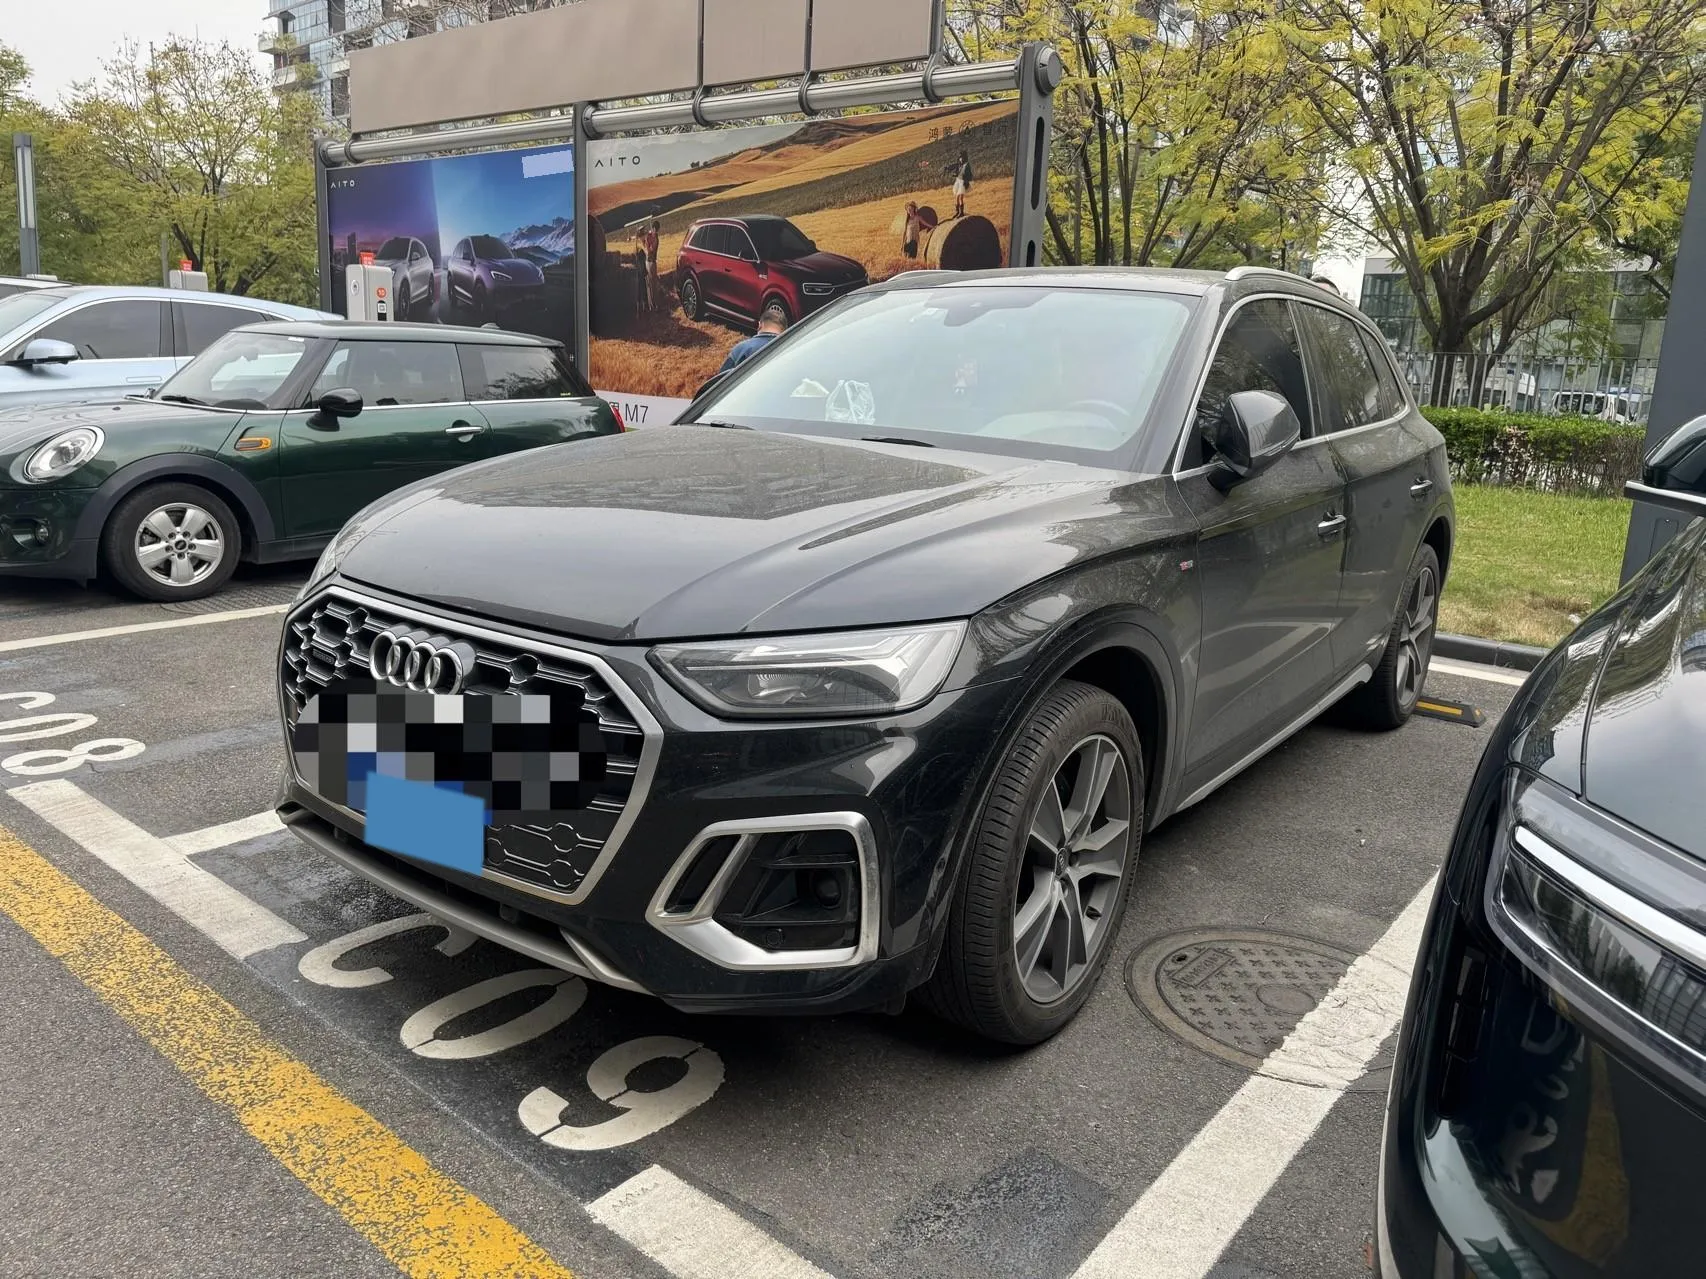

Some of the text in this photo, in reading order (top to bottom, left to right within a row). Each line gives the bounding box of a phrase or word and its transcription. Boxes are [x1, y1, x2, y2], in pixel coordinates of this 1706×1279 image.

[594, 155, 641, 168] AITO
[330, 179, 355, 189] AITO
[625, 403, 649, 424] M7
[298, 911, 726, 1151] C09
